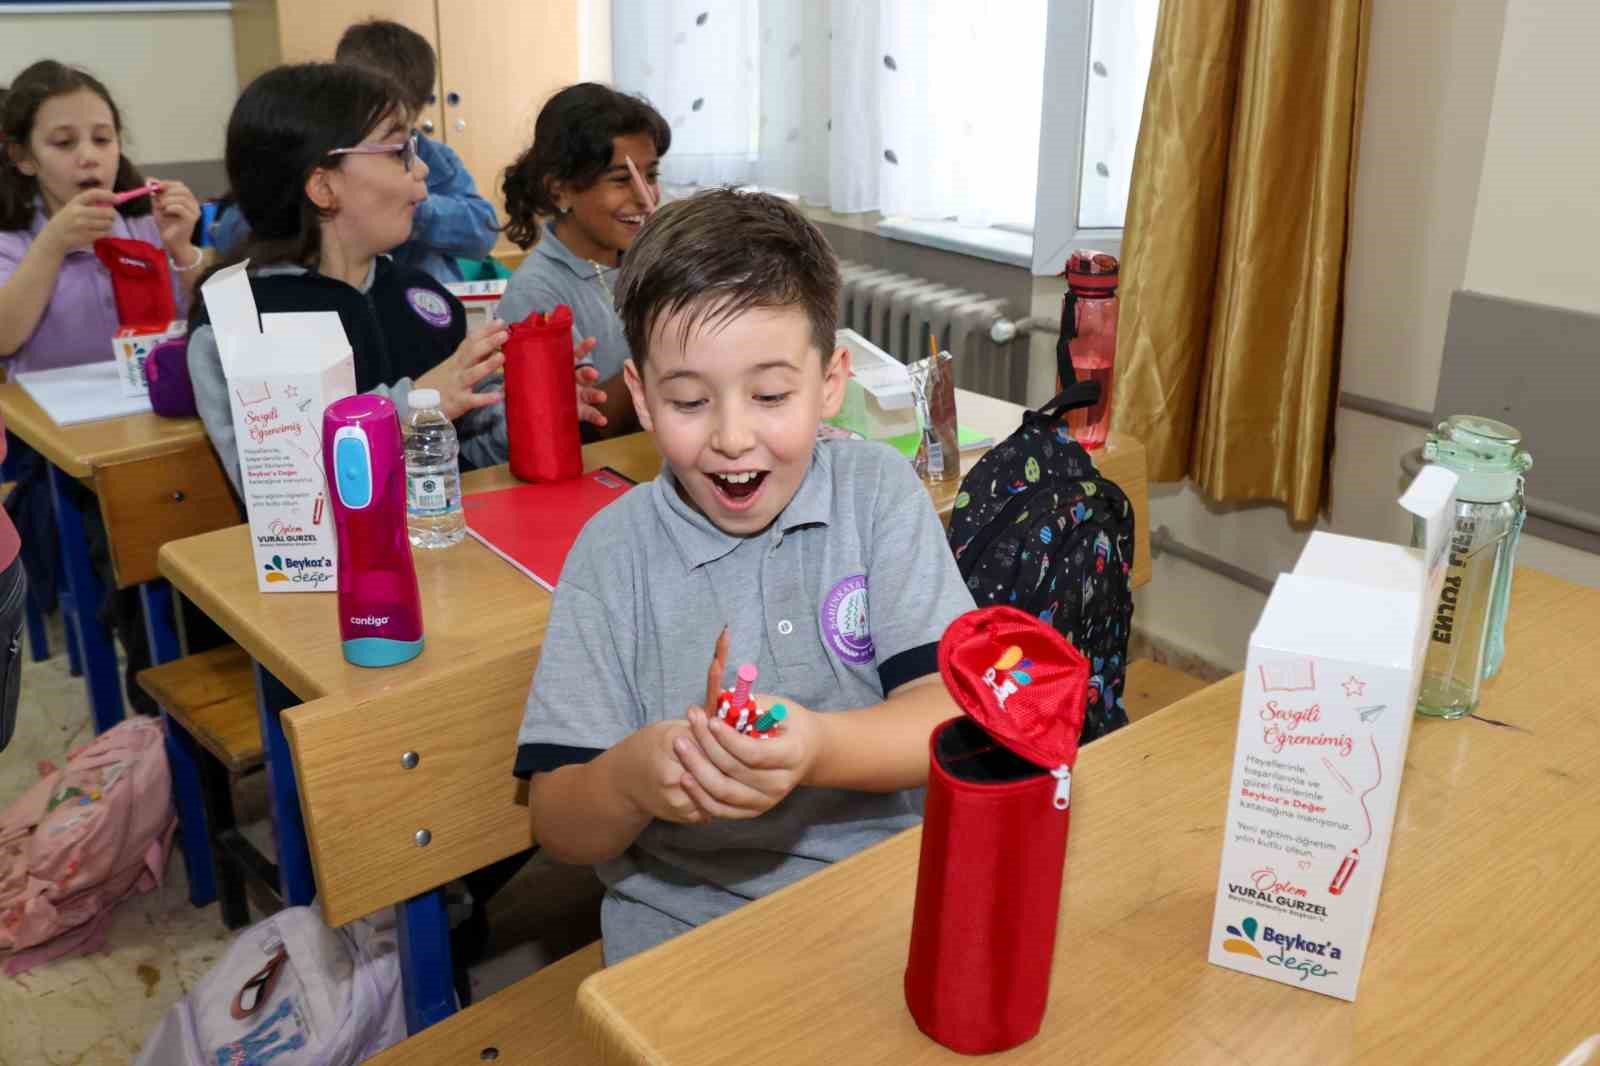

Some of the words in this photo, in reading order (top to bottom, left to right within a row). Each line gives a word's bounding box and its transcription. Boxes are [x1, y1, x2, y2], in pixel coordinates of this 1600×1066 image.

[285, 556, 332, 571] Beykoz'a
[350, 615, 389, 627] contigo
[1260, 700, 1321, 730] Sevgili
[1229, 883, 1273, 903] VURAL
[1262, 926, 1343, 961] Beykoz'a
[1267, 947, 1339, 982] değer
